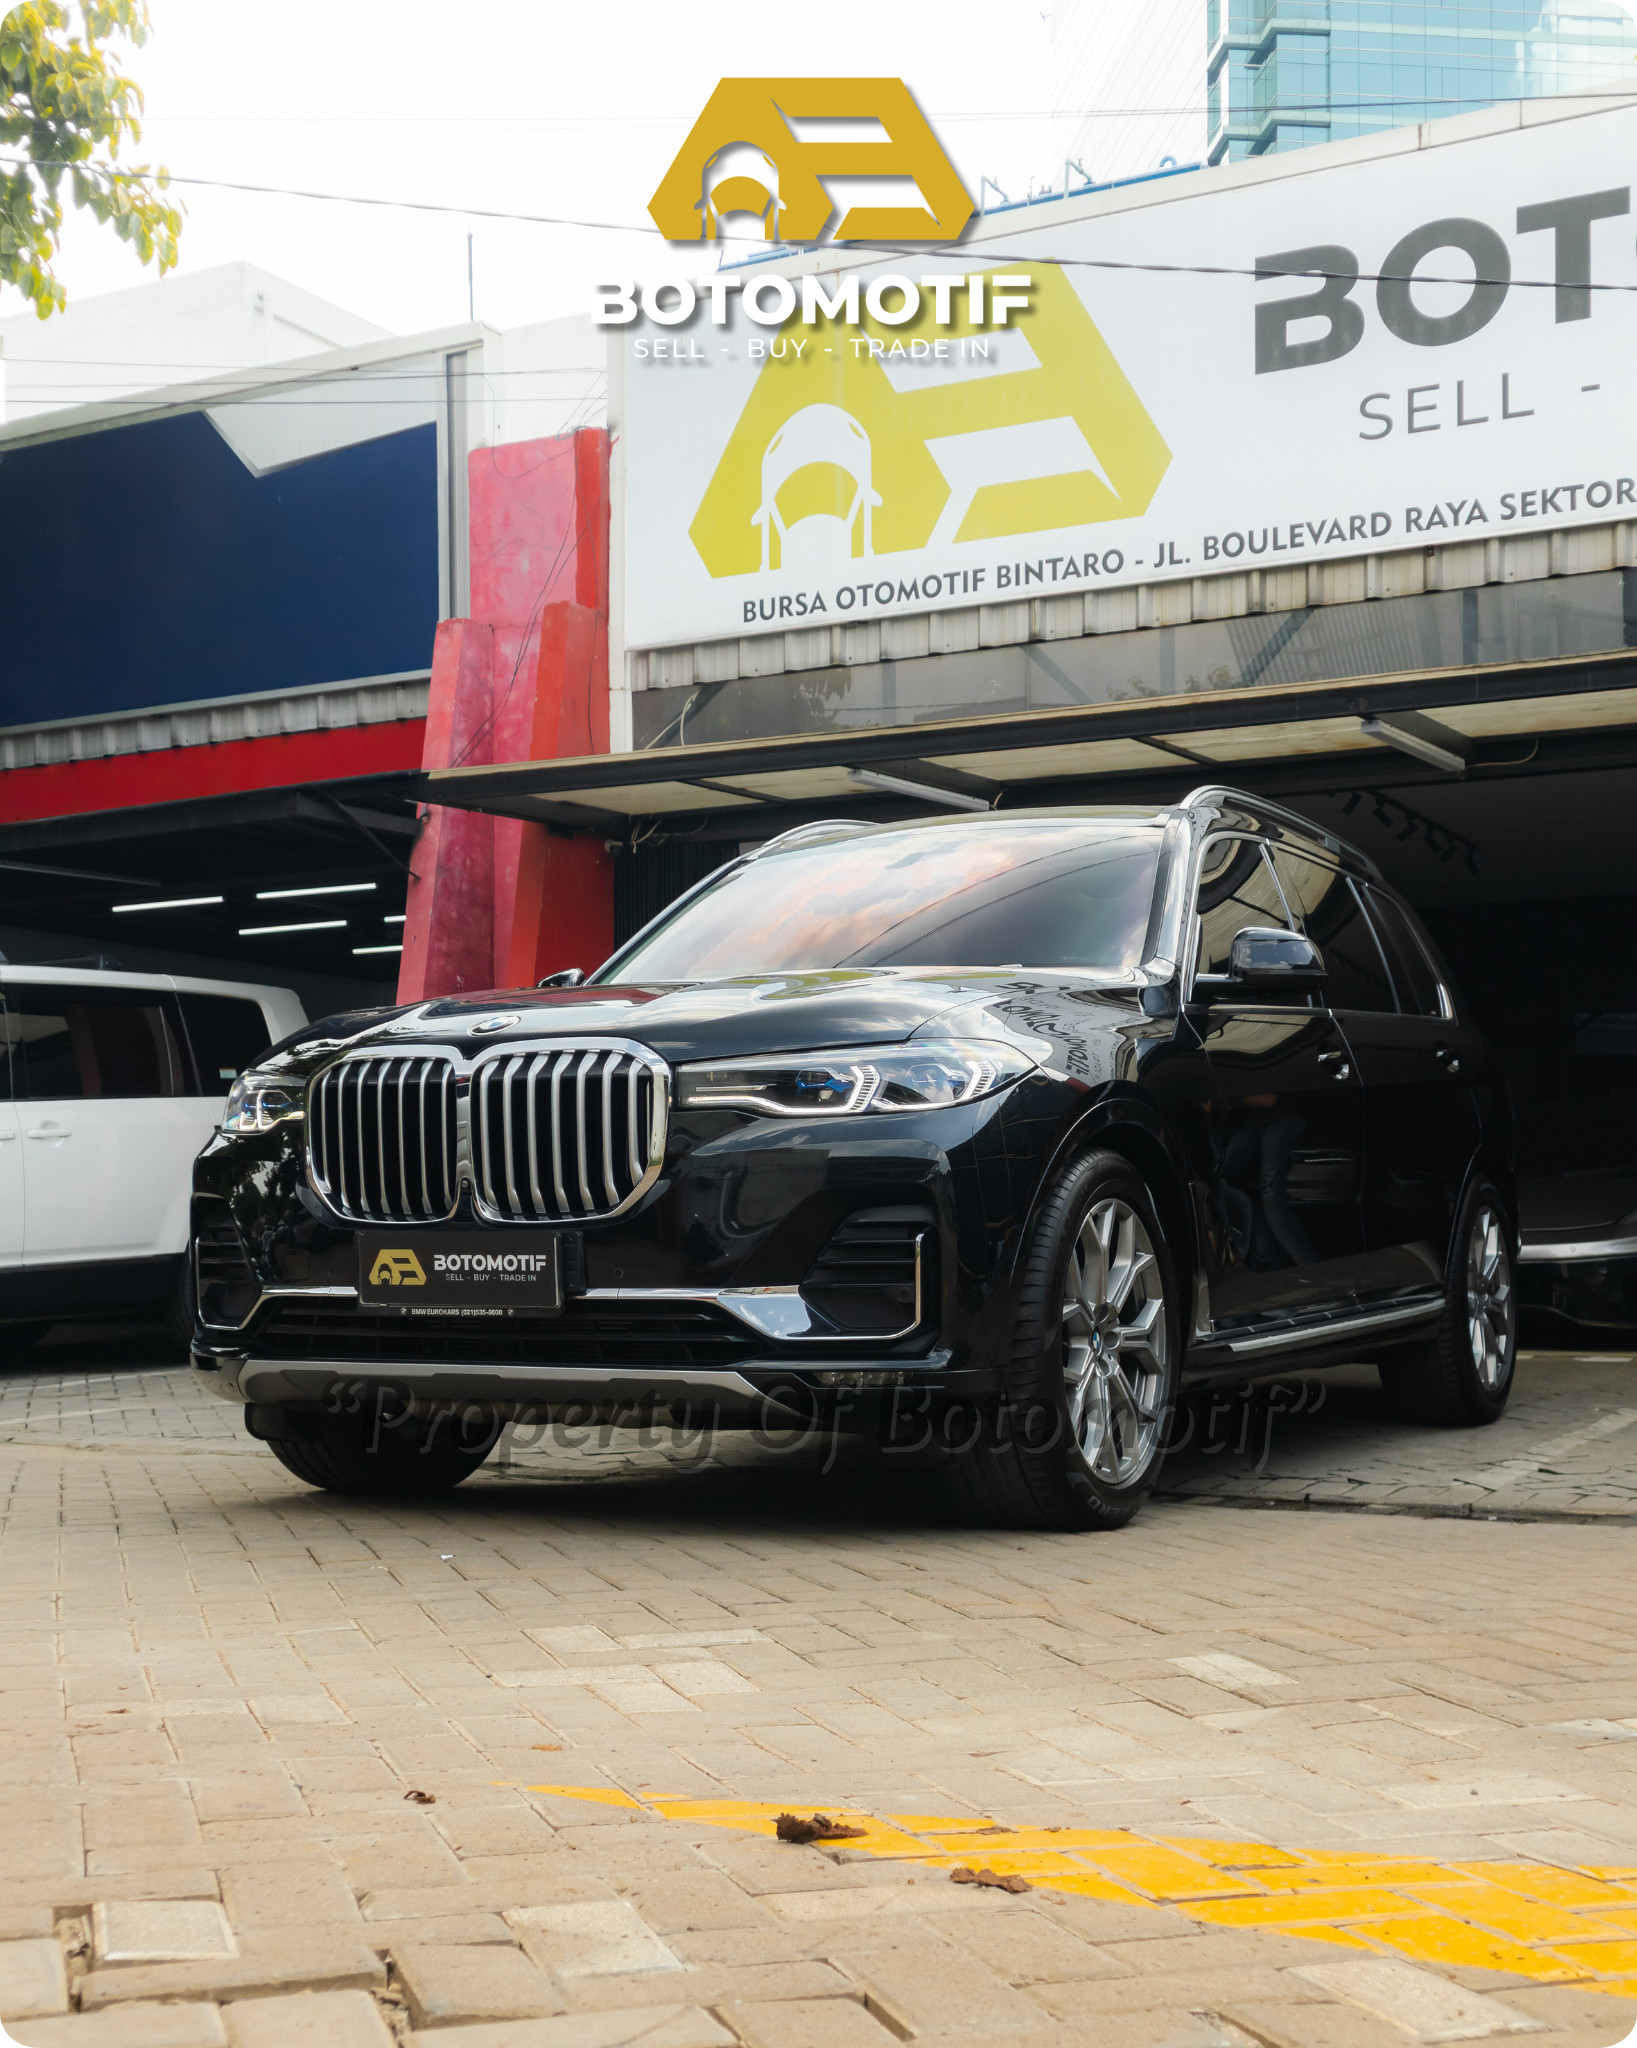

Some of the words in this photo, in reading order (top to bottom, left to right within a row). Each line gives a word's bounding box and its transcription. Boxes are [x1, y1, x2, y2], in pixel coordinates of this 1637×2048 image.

[1255, 185, 1637, 375] BOT
[1359, 372, 1536, 441] SELL
[743, 590, 828, 624] BURSA
[835, 567, 987, 610] OTOMOTIF
[996, 548, 1125, 590] BINTARO
[1153, 541, 1191, 568] JL.
[1203, 512, 1393, 561] BOULEVARD
[1405, 498, 1489, 533] RAYA
[1500, 477, 1637, 521] SEKTOR
[433, 1254, 547, 1271] BOTOMOTIF
[445, 1273, 464, 1281] SELL
[473, 1273, 490, 1281] BUY
